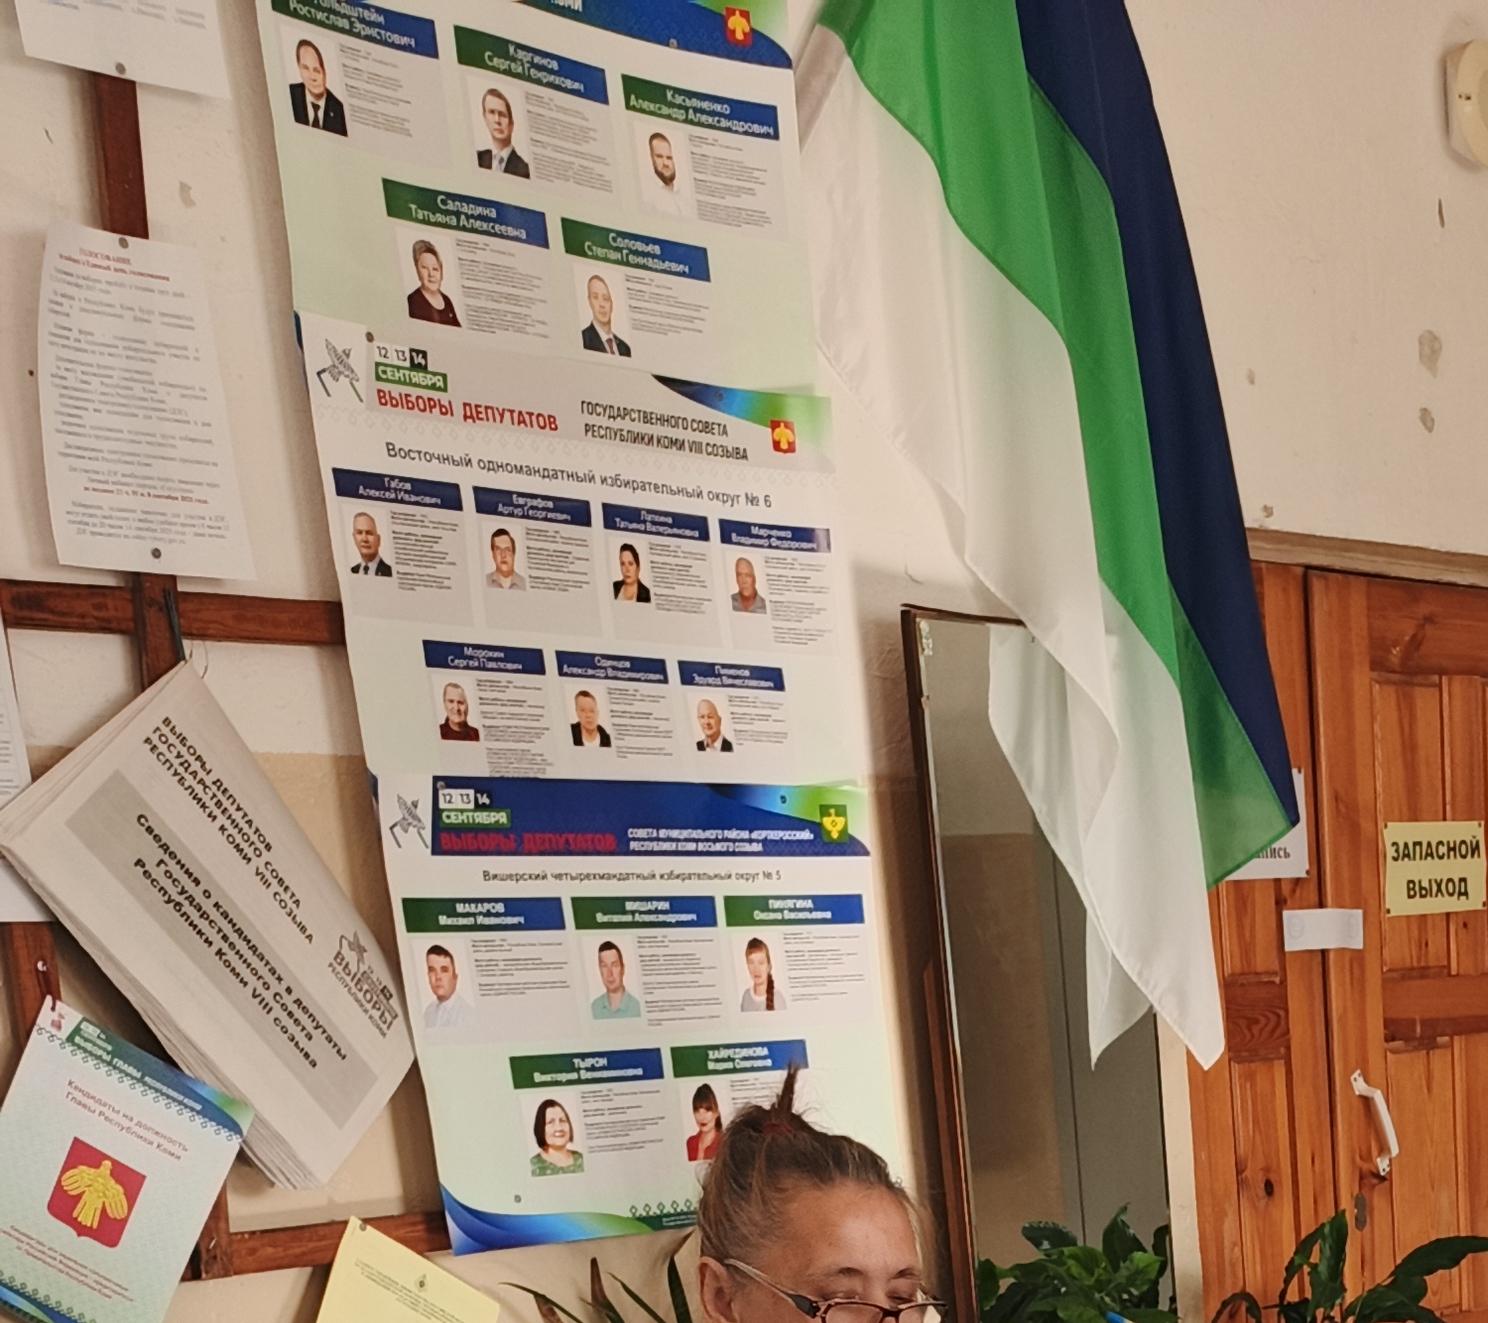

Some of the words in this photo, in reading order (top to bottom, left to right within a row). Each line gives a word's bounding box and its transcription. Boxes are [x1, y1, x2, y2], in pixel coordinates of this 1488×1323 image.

[313, 0, 385, 25] ольдштейн
[484, 51, 524, 74] Сергей
[508, 43, 559, 71] Каргинов
[629, 94, 686, 121] Александр
[687, 108, 774, 137] Александрович
[665, 89, 731, 115] Касьяненко
[437, 194, 497, 219] Саладина
[408, 203, 457, 227] Татьяна
[458, 214, 527, 240] Алексеевна
[608, 232, 661, 255] Соловьев
[584, 241, 622, 262] Степан
[621, 250, 690, 275] Геннадьевич
[376, 345, 389, 359] 12
[394, 349, 407, 362] 13
[411, 351, 426, 367] 14
[377, 365, 445, 389] СЕНТЯБРЯ
[376, 388, 455, 418] ВЫБОРЫ
[462, 402, 559, 431] ДЕПУТАТОВ
[581, 399, 689, 431] ГОСУДАРСТВЕННОГО
[690, 418, 729, 438] СОВЕТА
[584, 423, 654, 445] РЕСПУБЛИКИ
[656, 434, 685, 450] КОМИ
[704, 442, 748, 461] СОЗЫВА
[385, 441, 473, 469] Восточный
[477, 456, 596, 485] одномандатный
[599, 473, 704, 500] избирательный
[706, 489, 741, 507] округ
[745, 492, 759, 507] №
[763, 494, 772, 508] 6
[358, 485, 396, 500] Алексей
[447, 656, 480, 671] Сергей
[161, 716, 213, 776] ВЫБОРЫ
[211, 778, 273, 853] ДЕПУТАТОВ
[442, 793, 453, 804] 12
[460, 793, 471, 804] 13
[476, 793, 490, 805] 14
[152, 726, 263, 858] ГОСУДАРСТВЕННОГО
[264, 861, 301, 909] СОВЕТА
[442, 811, 508, 825] СЕНТЯБРЯ
[143, 736, 218, 823] РЕСПУБЛИКИ
[218, 824, 252, 865] КОМИ
[254, 865, 272, 890] VIII
[272, 891, 314, 944] СОЗЫВА
[439, 832, 516, 851] ВЫБОРЫ
[522, 833, 617, 853] ДЕПУТАТОВ
[1391, 835, 1480, 862] ЗАПАСНОЙ
[483, 869, 548, 884] Вишерский
[551, 870, 656, 885] четырехмандатный
[659, 869, 732, 882] избирательный
[734, 871, 760, 883] округ
[775, 870, 782, 881] 5
[1406, 877, 1469, 901] ВЫХОД
[456, 902, 505, 913] МАКАРОВ
[136, 813, 201, 888] Сведения
[202, 889, 212, 900] о
[213, 901, 284, 985] кандидатах
[292, 998, 347, 1061] депутаты
[155, 858, 271, 992] Государственного
[273, 992, 313, 1042] Совета
[133, 858, 213, 948] Республики
[214, 947, 249, 989] Коми
[251, 988, 273, 1015] VIII
[273, 1016, 318, 1069] созыва
[333, 950, 394, 1031] ВЫБОРЫ
[572, 1057, 608, 1069] ТЫРОН
[65, 1091, 96, 1115] Главы
[98, 1109, 154, 1147] Республики
[155, 1142, 181, 1161] Коми
[67, 1079, 121, 1115] Кандидаты
[122, 1112, 134, 1122] на
[134, 1118, 188, 1153] должность
